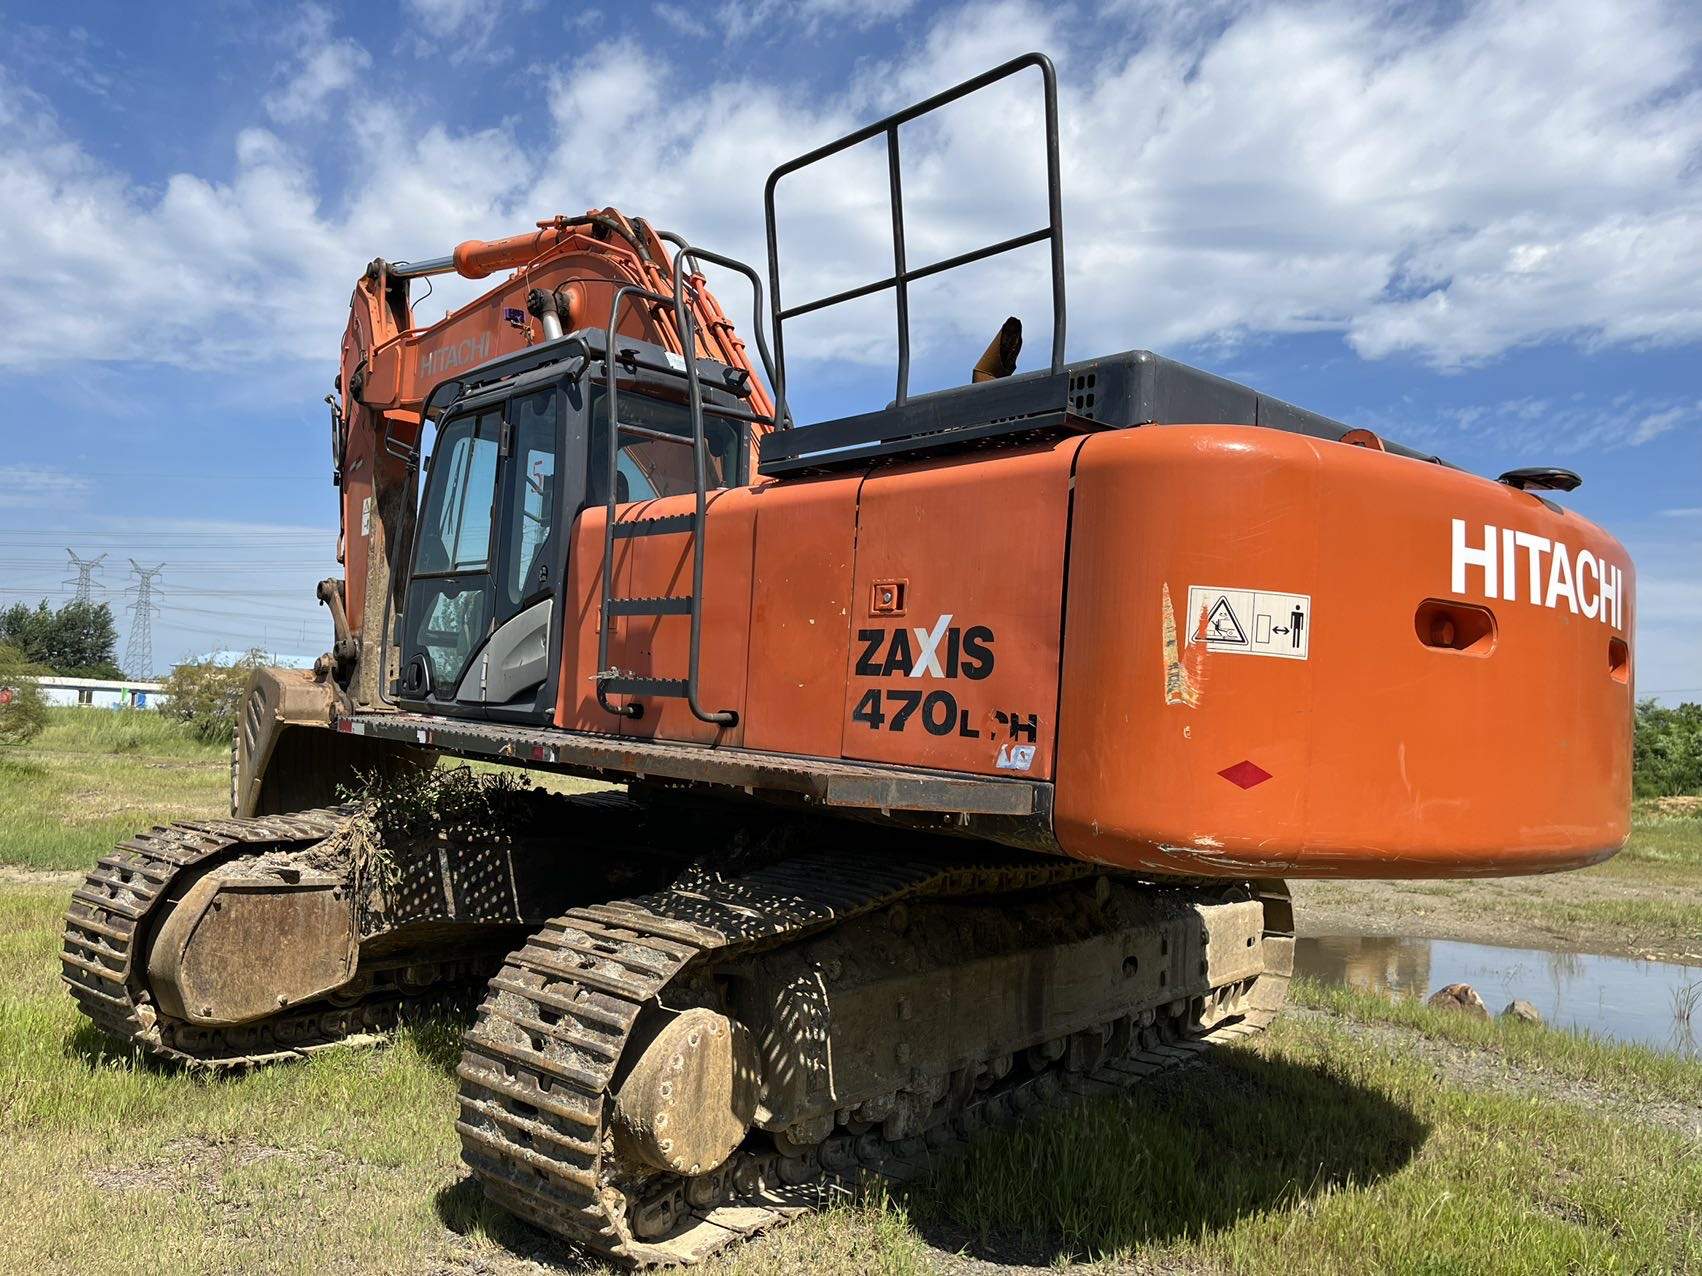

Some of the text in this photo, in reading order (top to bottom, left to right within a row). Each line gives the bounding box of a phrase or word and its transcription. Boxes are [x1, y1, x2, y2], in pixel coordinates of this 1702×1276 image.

[420, 331, 491, 378] HITACHI
[1451, 518, 1622, 631] HITACHI
[855, 614, 995, 680] ZAXIS
